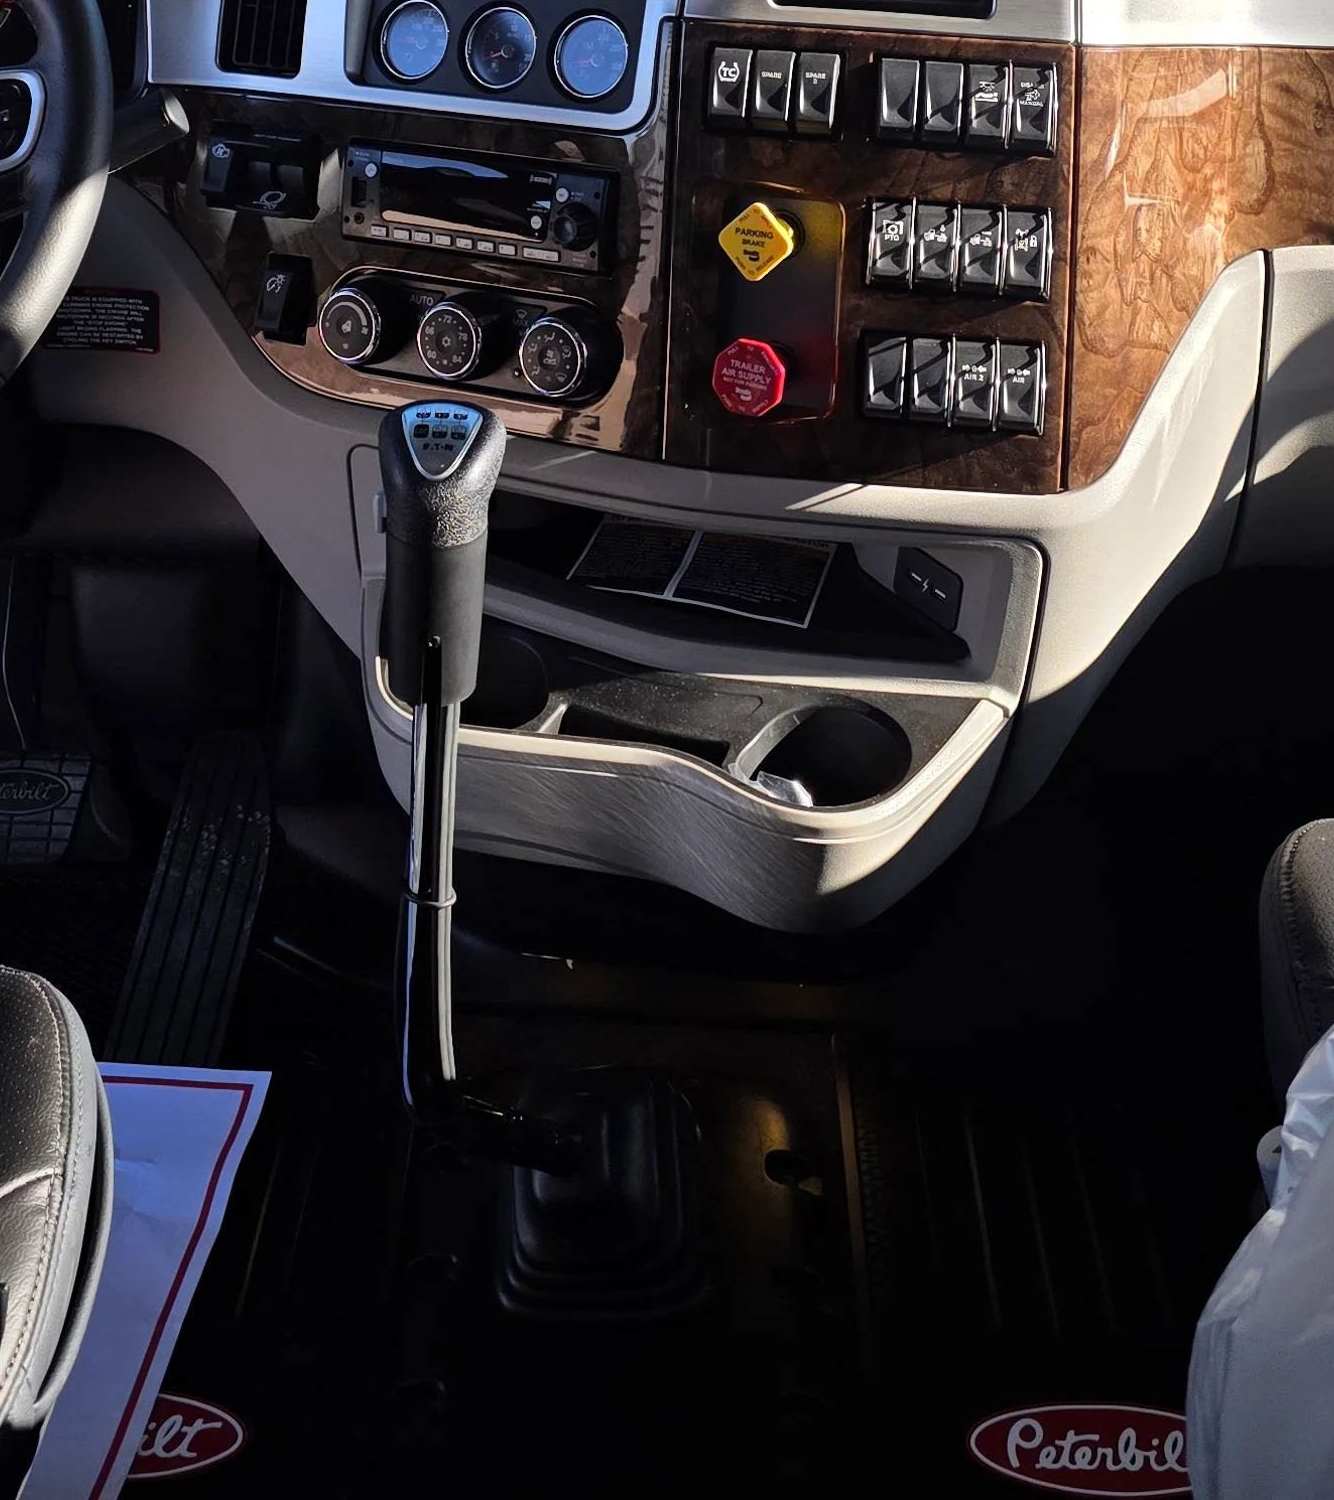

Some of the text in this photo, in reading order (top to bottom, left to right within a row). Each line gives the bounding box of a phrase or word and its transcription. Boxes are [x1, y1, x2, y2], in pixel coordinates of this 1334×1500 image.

[722, 67, 737, 77] TC
[734, 227, 774, 240] PARKING
[884, 234, 900, 242] PTO
[742, 238, 766, 248] BRAKE
[410, 295, 434, 306] AUTO
[442, 314, 453, 323] 72
[452, 355, 463, 364] 84
[730, 359, 766, 375] TRAILER
[721, 367, 772, 385] AIR SUPPLY
[963, 373, 977, 381] AIR
[1012, 376, 1025, 384] AIR
[1007, 1417, 1188, 1472] Peterbil
